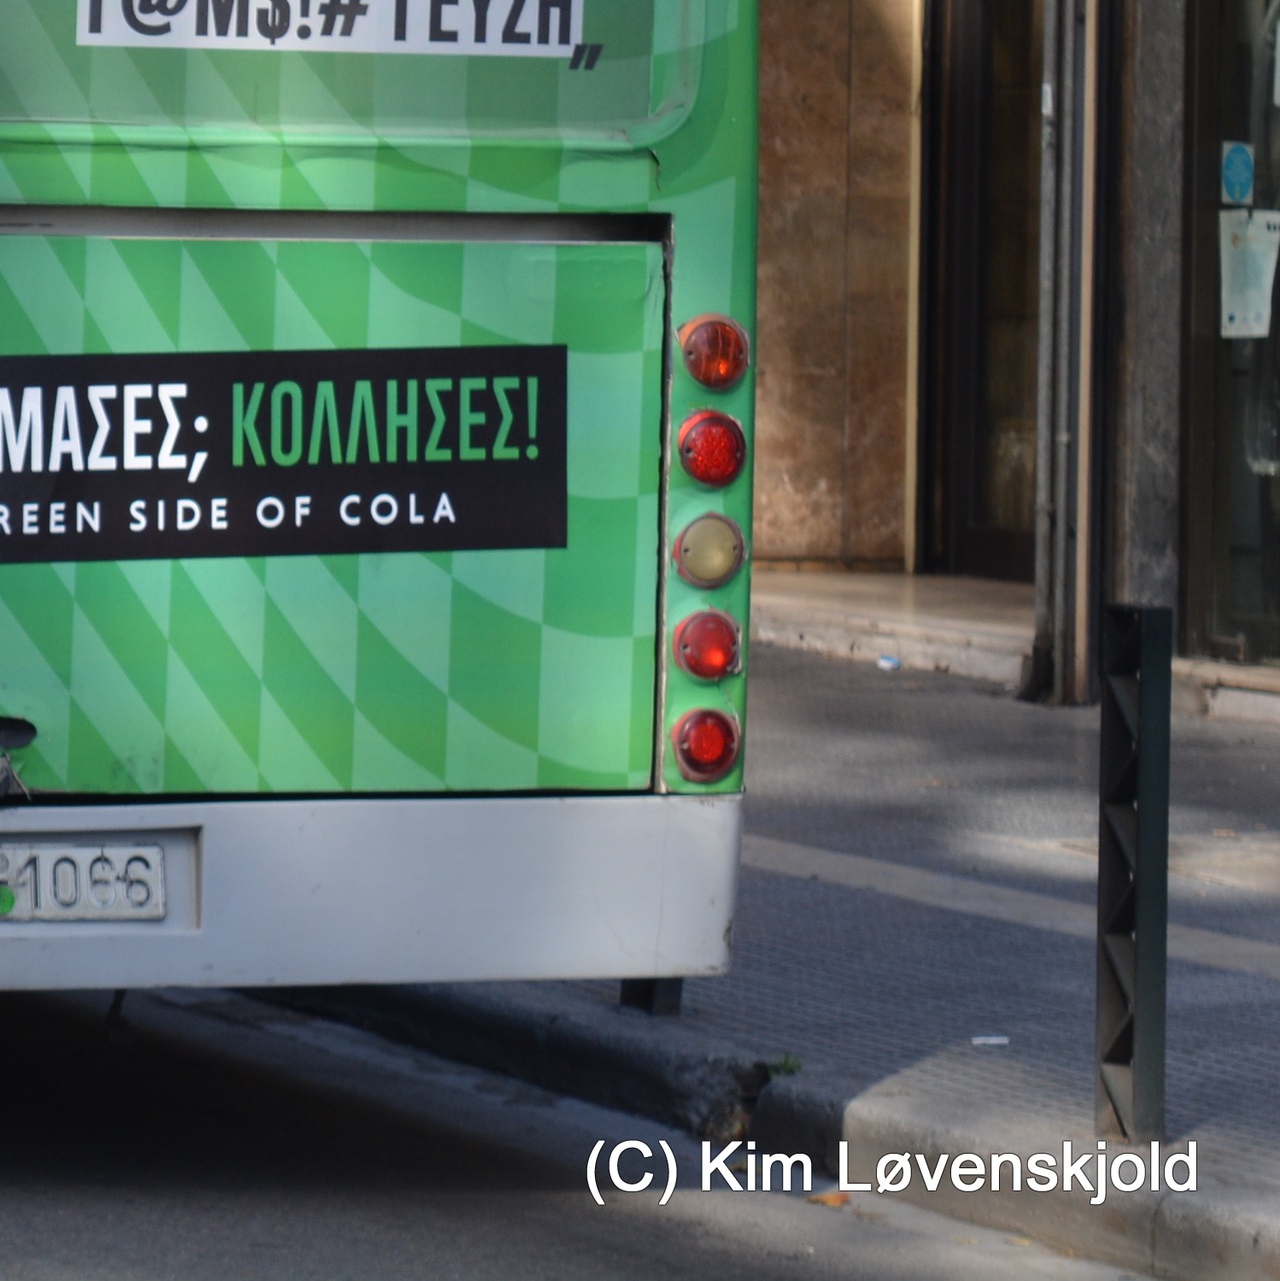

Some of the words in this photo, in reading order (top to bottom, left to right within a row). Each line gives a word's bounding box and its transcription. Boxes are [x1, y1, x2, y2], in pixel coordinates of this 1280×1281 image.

[232, 376, 539, 467] ΚΟΛΛΗΣΕΣ!
[129, 498, 229, 532] SIDE
[256, 495, 312, 529] OF
[339, 492, 456, 527] COLA
